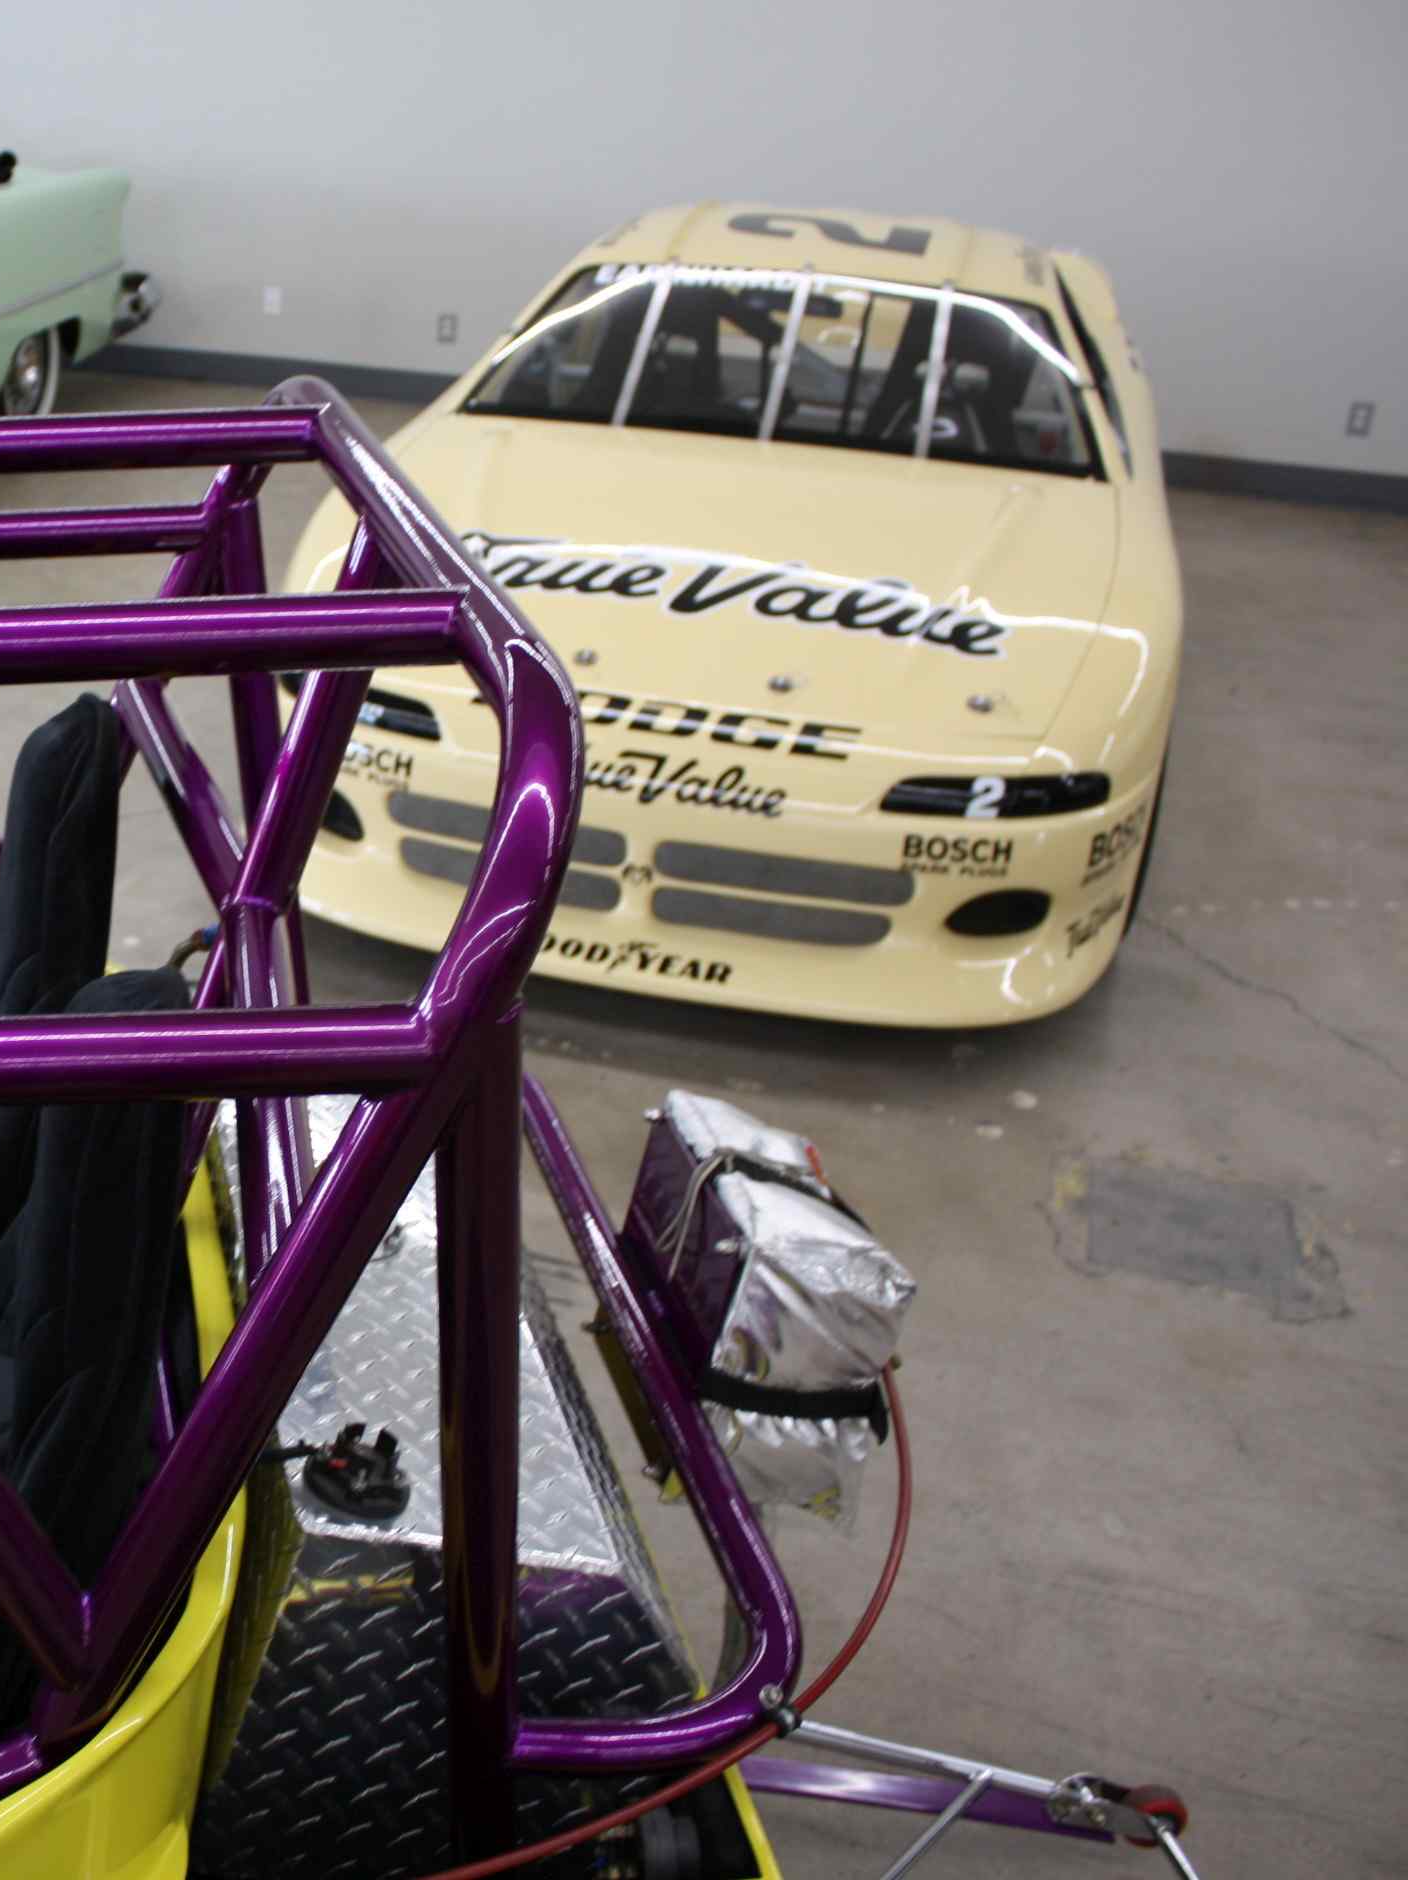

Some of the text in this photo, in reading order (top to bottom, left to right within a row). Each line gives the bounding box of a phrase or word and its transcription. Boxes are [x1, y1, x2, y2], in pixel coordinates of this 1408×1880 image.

[667, 558, 1005, 656] Value
[575, 689, 862, 761] ODGE
[581, 745, 786, 818] ue Value
[964, 776, 1006, 819] 2
[902, 834, 1014, 863] BOSCH
[544, 934, 733, 984] ODYEAR
